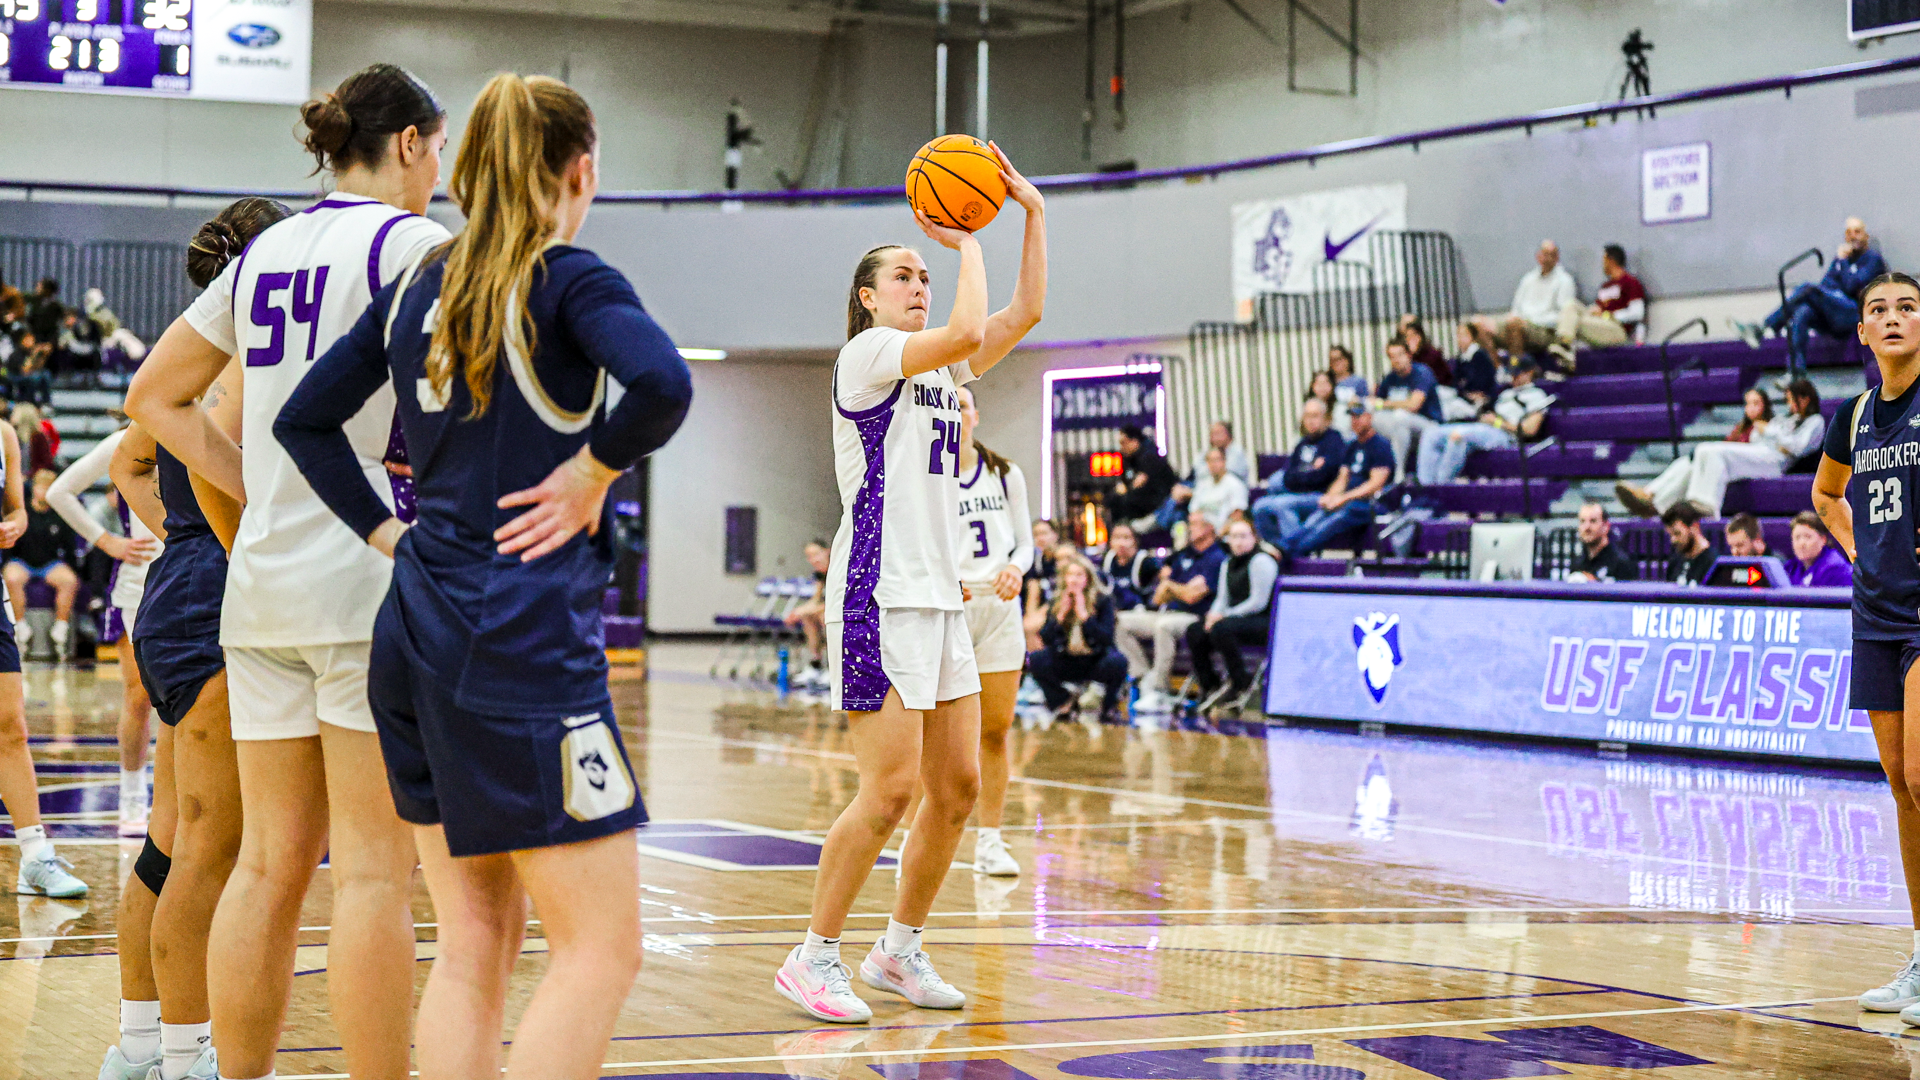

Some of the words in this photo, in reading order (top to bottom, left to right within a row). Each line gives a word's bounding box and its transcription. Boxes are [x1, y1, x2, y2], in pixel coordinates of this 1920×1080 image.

[246, 265, 330, 367] 54
[928, 417, 961, 479] 24
[1868, 476, 1902, 524] 23
[969, 520, 989, 558] 3
[1632, 605, 1725, 641] WELCOME
[1732, 609, 1756, 642] TO
[1764, 610, 1801, 644] THE
[1540, 636, 1650, 716] USF
[1651, 642, 1873, 733] CLASSI
[1606, 719, 1674, 743] PRESENTED
[1677, 724, 1694, 744] BY
[1725, 728, 1807, 752] HOSPITALITY
